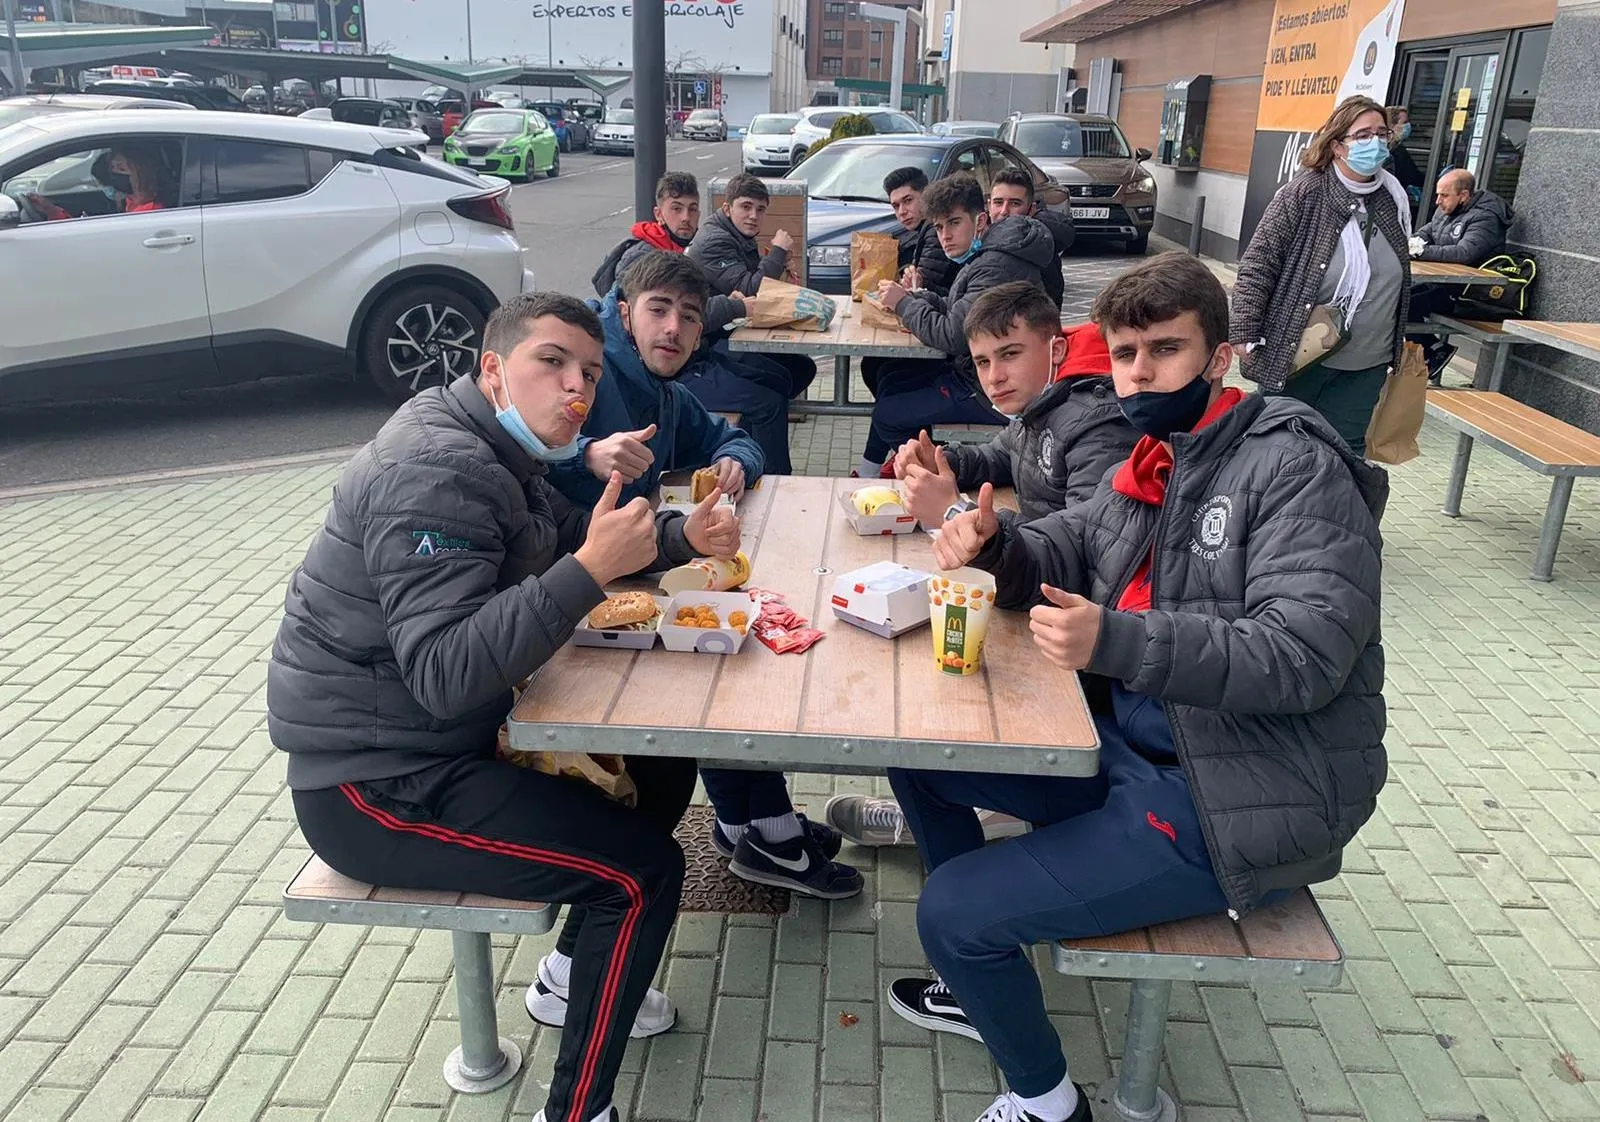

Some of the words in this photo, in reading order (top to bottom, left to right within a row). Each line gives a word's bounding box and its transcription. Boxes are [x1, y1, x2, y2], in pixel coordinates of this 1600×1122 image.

[532, 5, 615, 18] EXPERTOS
[622, 5, 633, 17] E
[1275, 12, 1309, 35] ¡Estamos
[1310, 3, 1350, 25] abiertos!
[1270, 46, 1287, 66] VEN,
[1289, 42, 1317, 63] ENTRA
[1265, 80, 1283, 97] PIDE
[1284, 80, 1290, 95] Y
[1290, 73, 1338, 96] LLÉVATELO
[1091, 209, 1108, 217] JVJ
